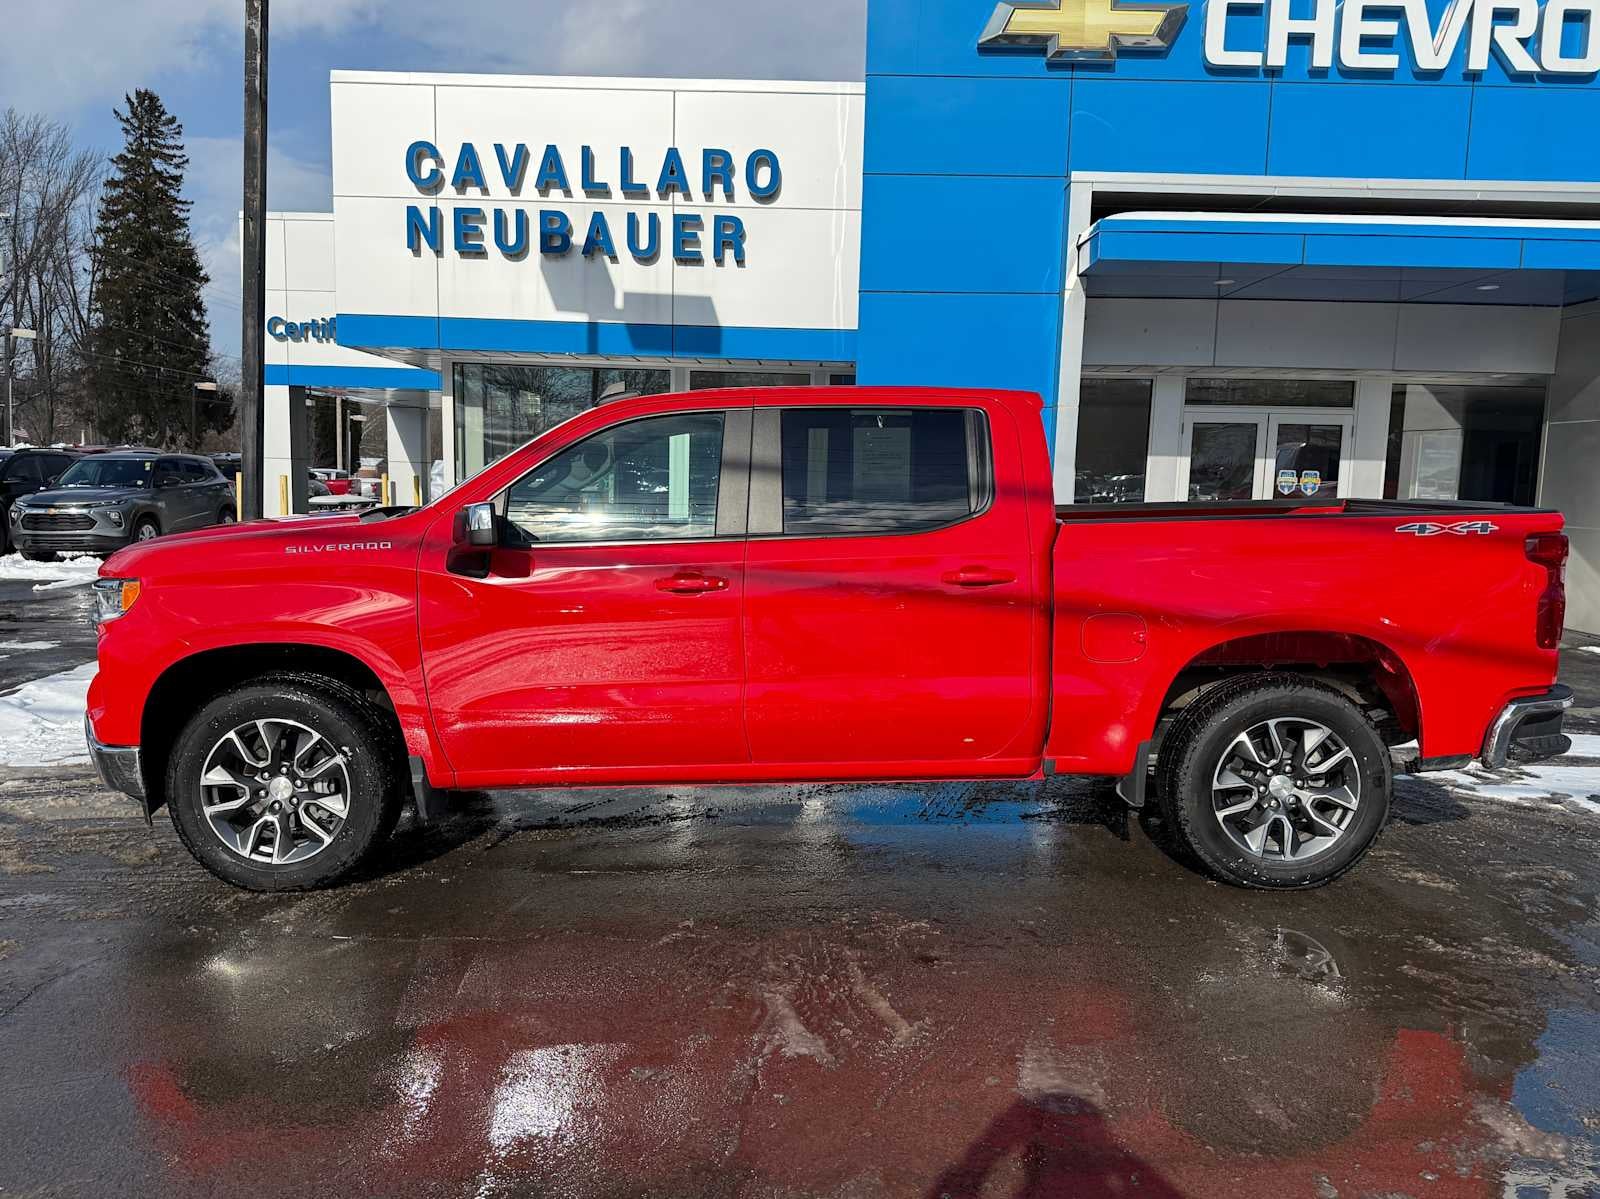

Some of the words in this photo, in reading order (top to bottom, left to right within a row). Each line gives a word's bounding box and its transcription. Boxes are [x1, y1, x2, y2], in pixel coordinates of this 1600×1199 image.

[1205, 0, 1600, 74] CHEVRO
[405, 140, 783, 202] CAVALLARO
[406, 205, 746, 265] NEUBAUER
[285, 541, 392, 553] SILVERADO
